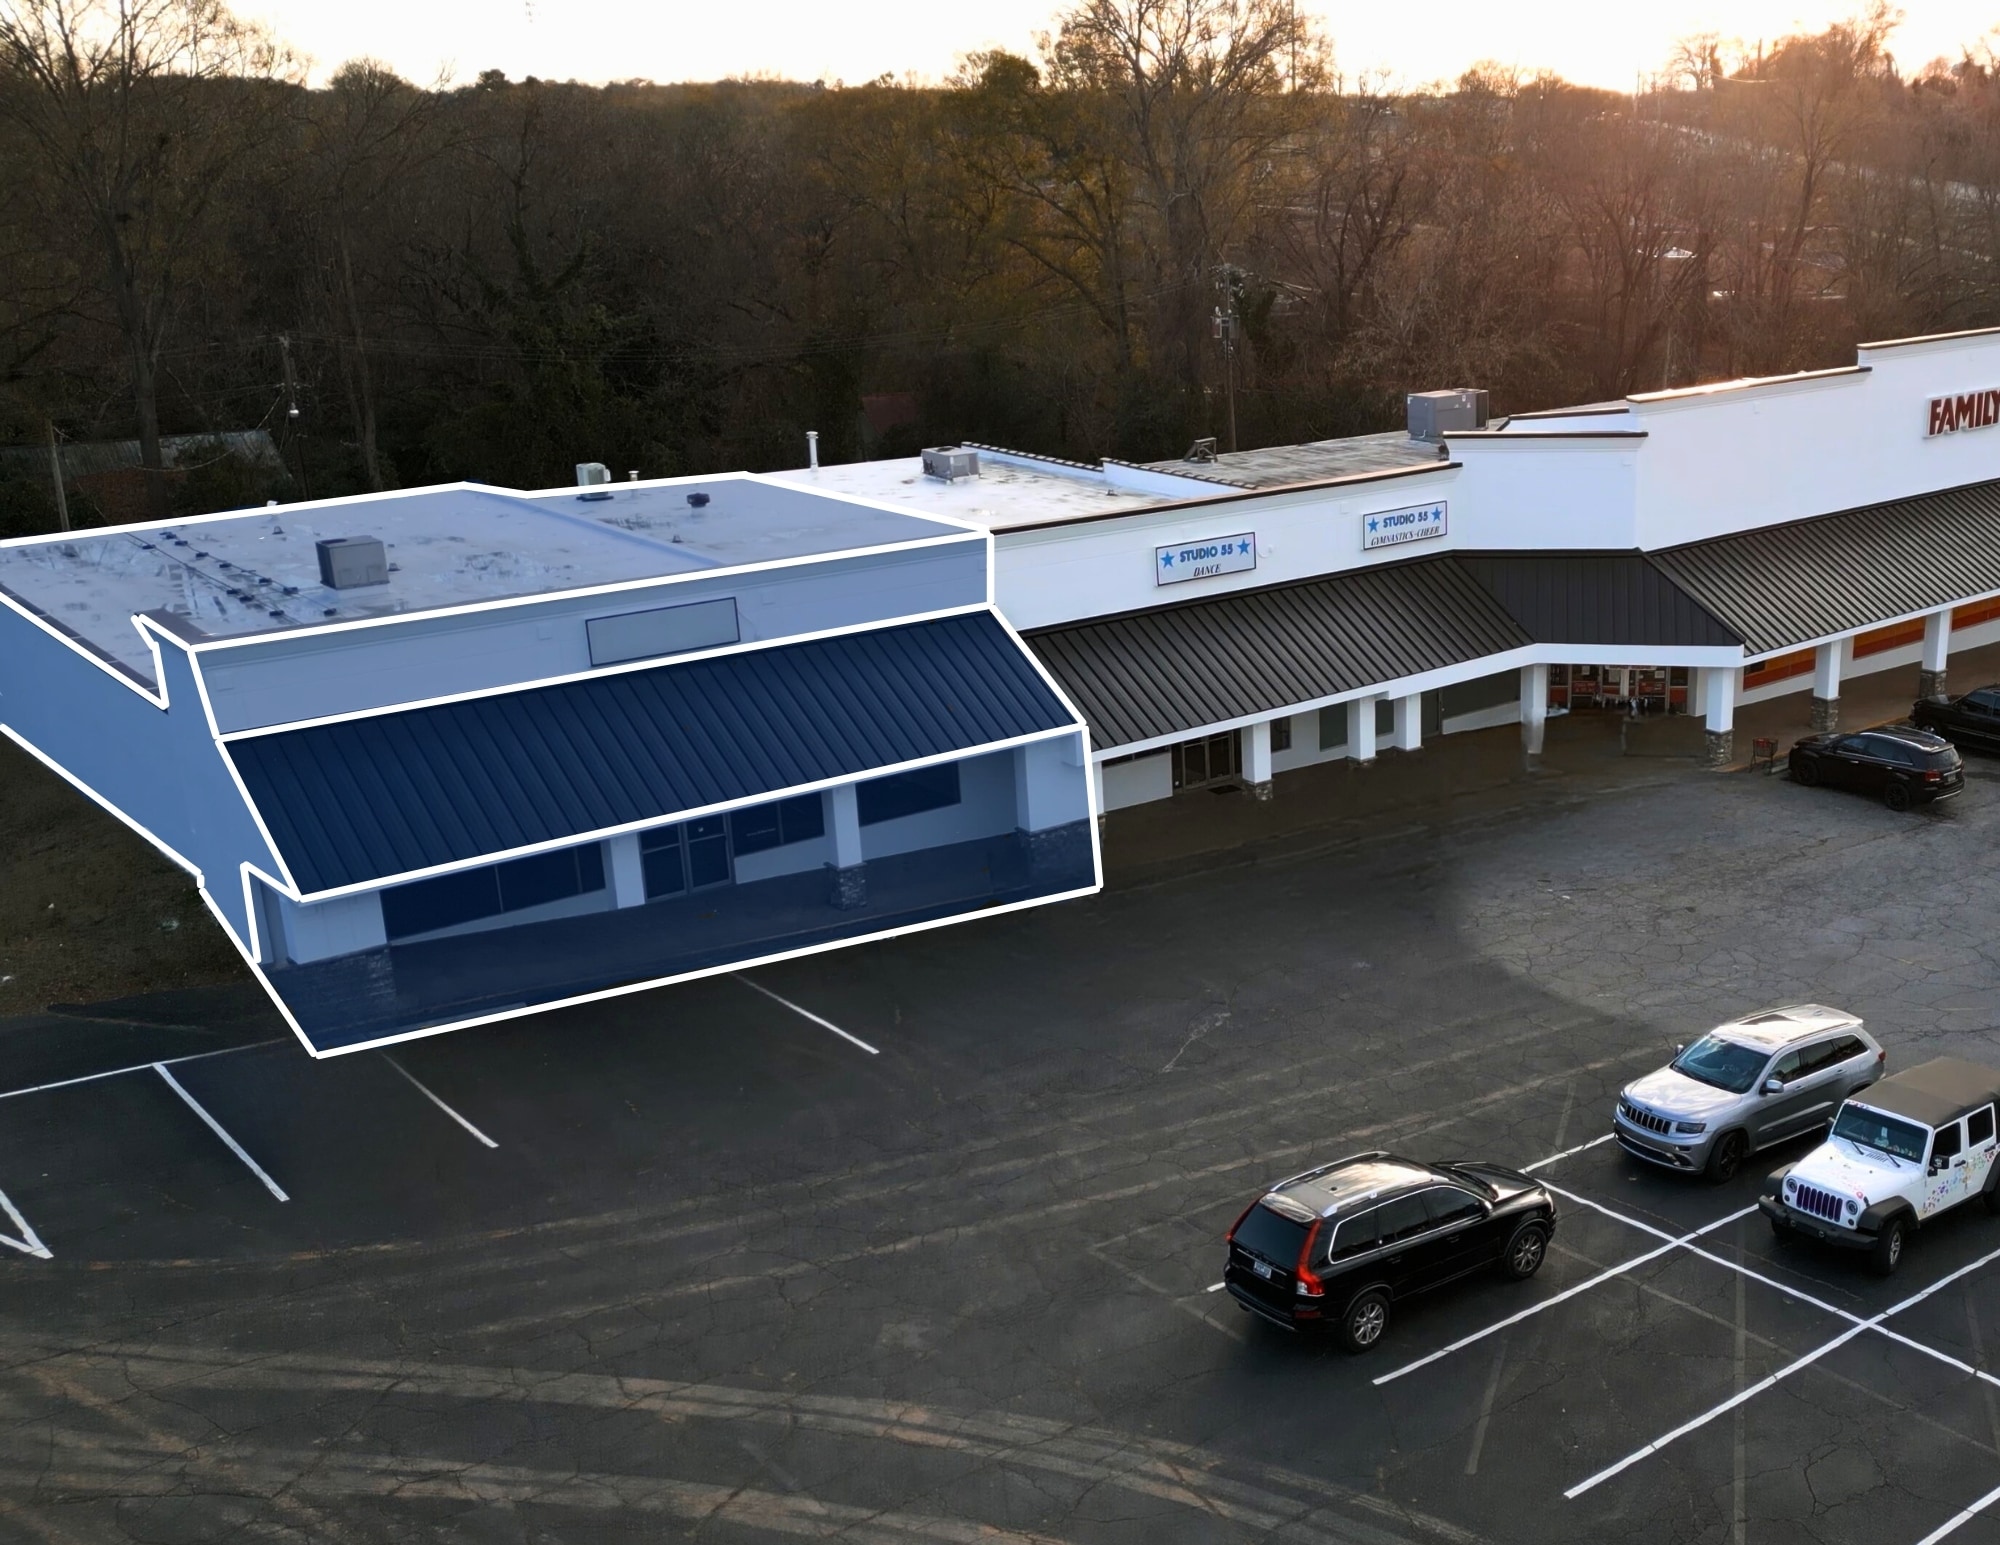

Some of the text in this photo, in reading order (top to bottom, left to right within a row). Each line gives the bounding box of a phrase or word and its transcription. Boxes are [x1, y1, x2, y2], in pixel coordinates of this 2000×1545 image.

[1927, 389, 2000, 436] FAMILY
[1383, 511, 1429, 528] STUDIO 55
[1180, 543, 1234, 563] STUDIO 55
[1193, 563, 1221, 577] DANCE
